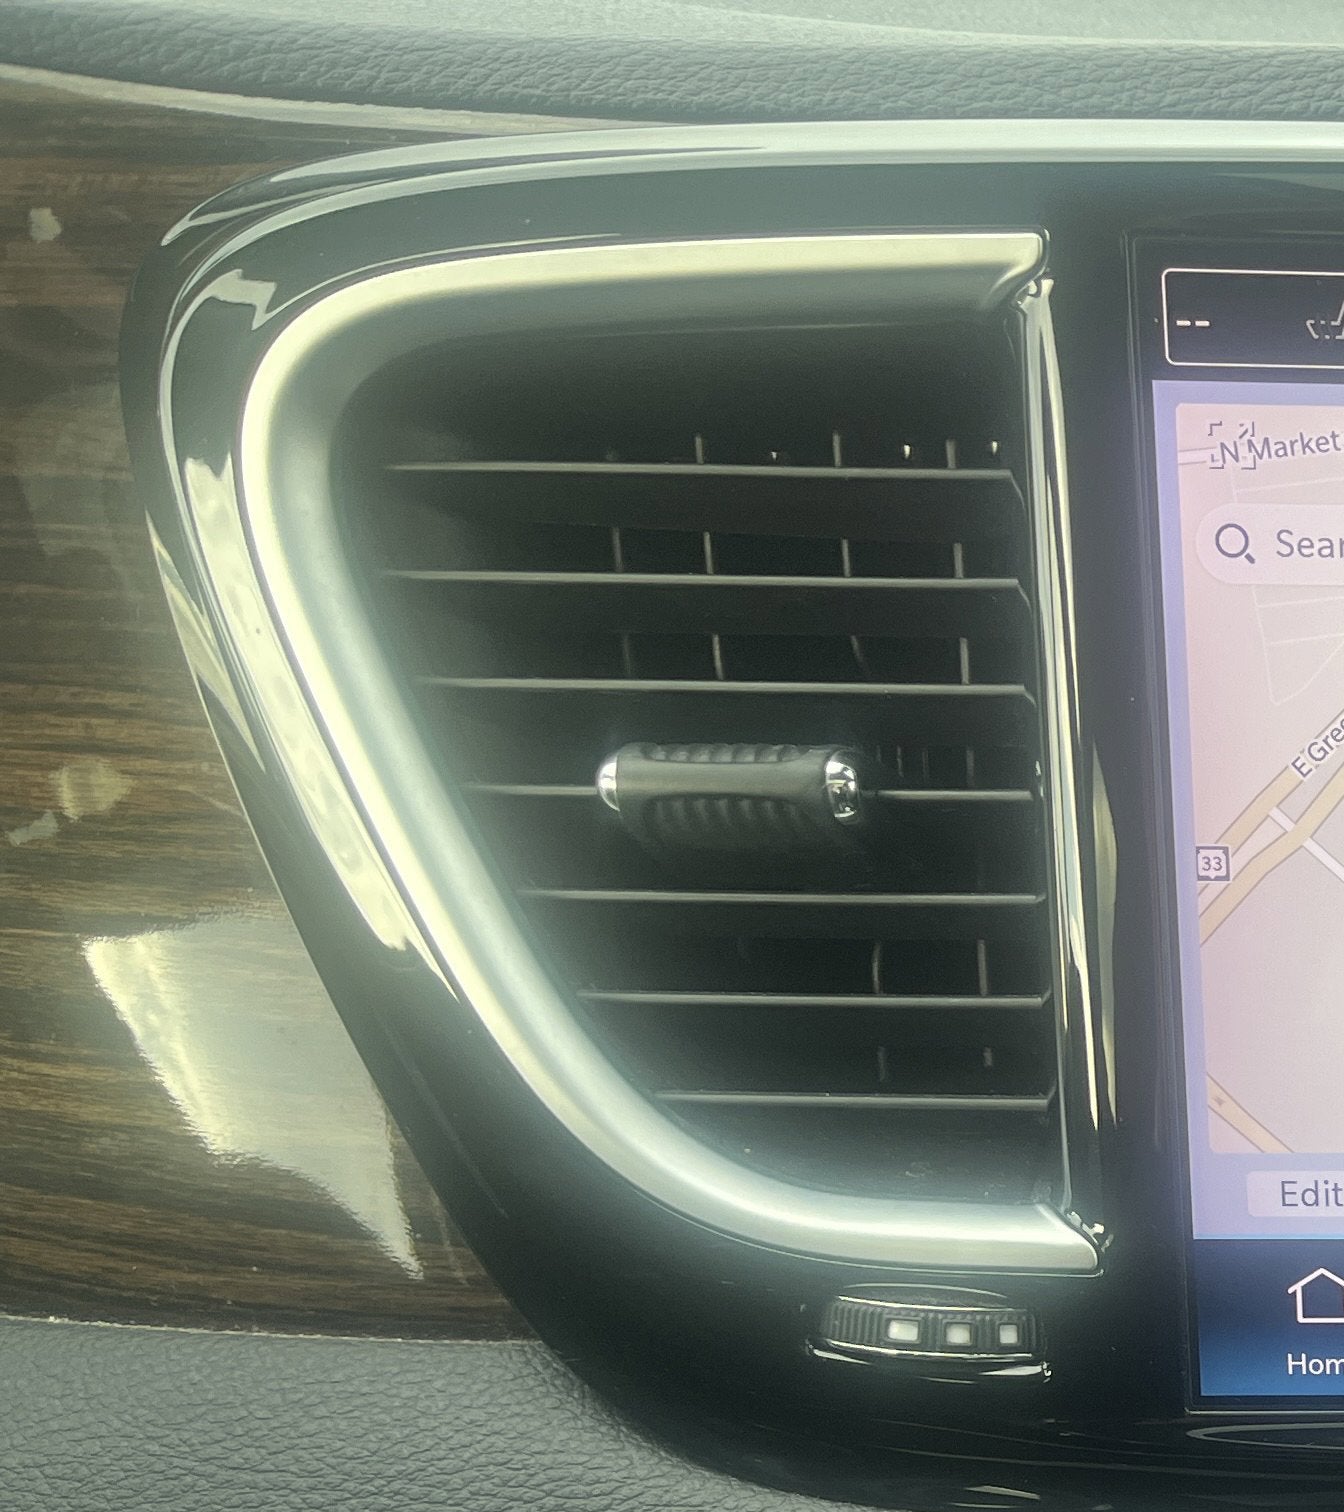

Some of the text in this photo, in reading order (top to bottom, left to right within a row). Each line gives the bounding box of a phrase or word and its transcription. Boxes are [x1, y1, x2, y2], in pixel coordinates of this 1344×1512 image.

[1246, 429, 1342, 461] Market
[1290, 756, 1313, 778] E
[1200, 855, 1223, 872] 33
[1280, 1179, 1344, 1209] Edit
